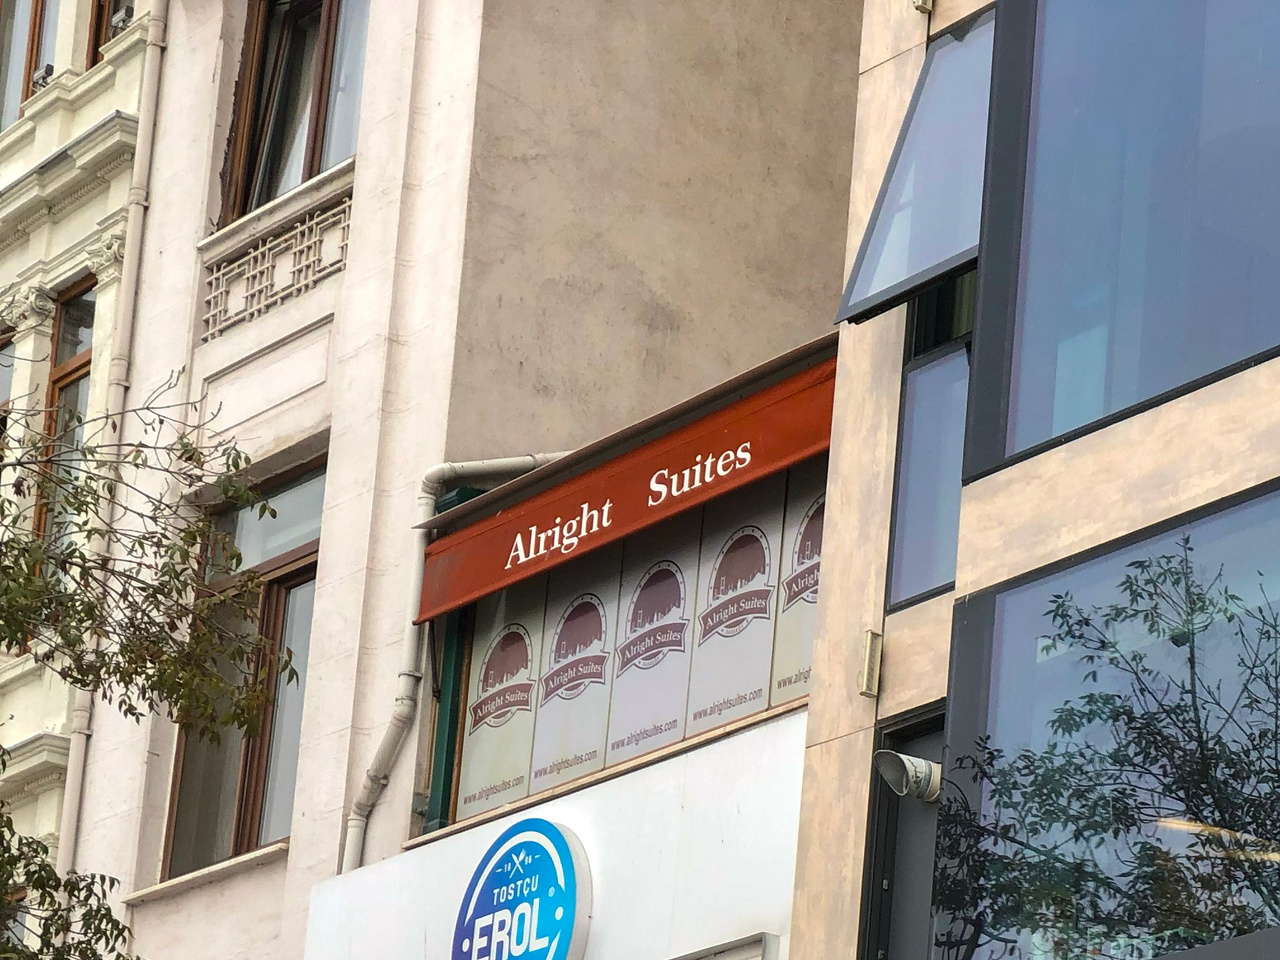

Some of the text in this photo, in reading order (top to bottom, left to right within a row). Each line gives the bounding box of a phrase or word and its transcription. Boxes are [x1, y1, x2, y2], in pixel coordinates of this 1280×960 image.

[504, 440, 752, 570] Alright Suites
[790, 569, 820, 596] Alrigh
[707, 597, 766, 628] Alright Suites
[623, 638, 655, 662] Alright
[655, 629, 682, 647] Suites
[547, 661, 603, 692] Alright Suites
[475, 696, 504, 720] Alright
[505, 690, 529, 707] Suites
[692, 687, 763, 722] www.alrightsuites.com
[610, 718, 678, 752] www.alrightsuites.com
[533, 749, 598, 780] www.alrightsuites.com
[463, 774, 525, 806] www.alrightsuites.com
[492, 873, 539, 906] TOSTÇU
